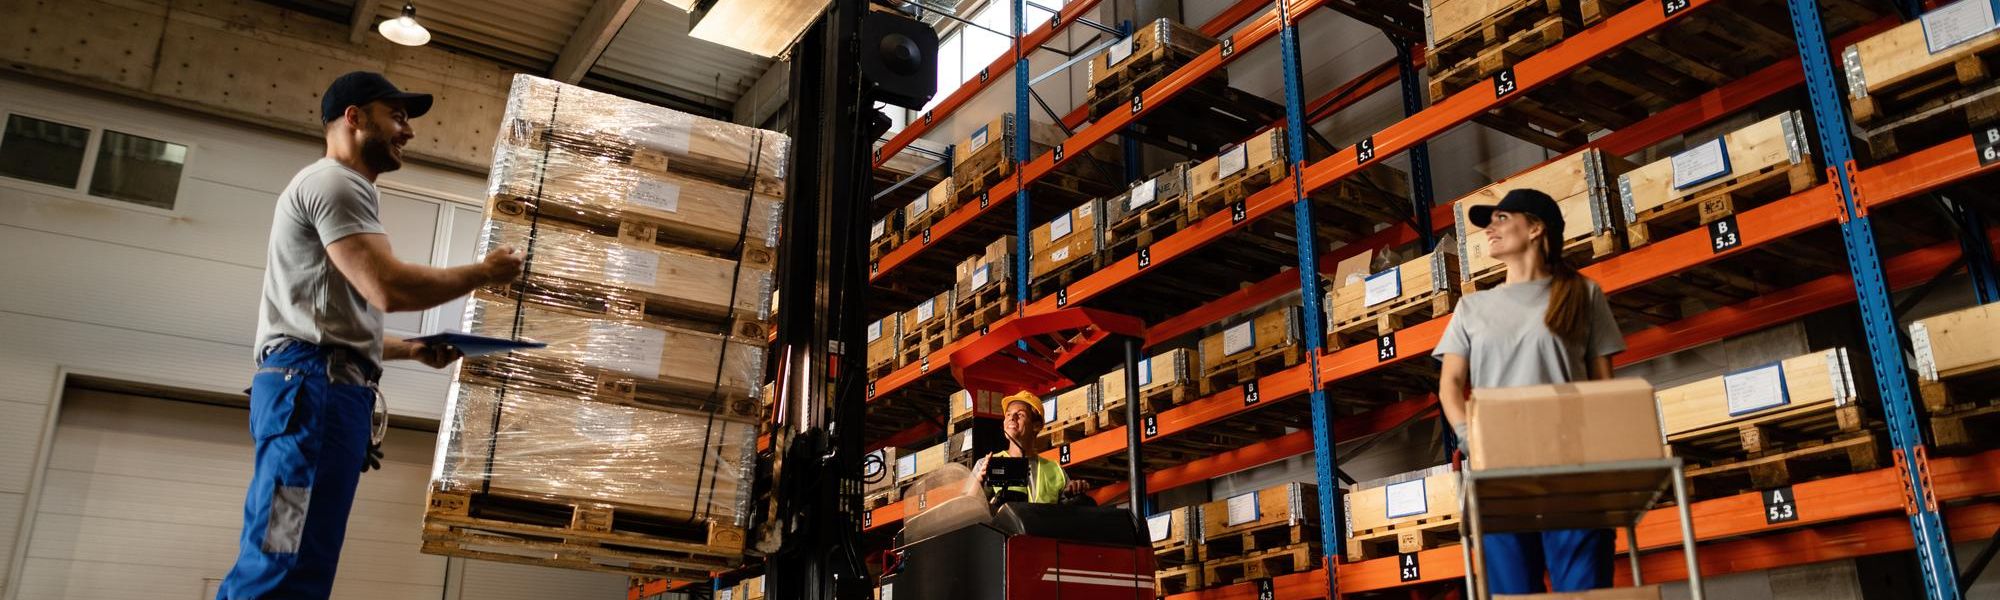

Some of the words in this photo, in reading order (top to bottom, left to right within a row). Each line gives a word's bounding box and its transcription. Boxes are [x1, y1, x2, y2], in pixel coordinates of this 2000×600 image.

[1667, 0, 1685, 13] 5.3
[1224, 39, 1230, 48] D
[1222, 45, 1232, 56] 4.3
[1500, 71, 1507, 81] C
[1498, 81, 1514, 95] 5.2
[1134, 96, 1140, 104] D
[1986, 129, 2000, 143] B
[1362, 139, 1368, 149] C
[1360, 148, 1372, 162] 5.1
[1236, 202, 1241, 211] C
[1234, 211, 1245, 221] 4.3
[1718, 221, 1728, 234] B
[1715, 233, 1736, 249] 5.3
[1141, 249, 1146, 257] C
[1060, 289, 1064, 297] C
[1383, 336, 1390, 347] B
[1380, 346, 1394, 359] 5.1
[1248, 383, 1254, 392] B
[1246, 392, 1258, 403] 4.3
[1148, 417, 1153, 426] B
[1146, 426, 1156, 435] 4.2
[1773, 489, 1784, 504] A
[1770, 505, 1793, 520] 5.3
[1406, 555, 1413, 566] A
[1403, 566, 1417, 579] 5.1
[1262, 580, 1269, 590] A
[1260, 591, 1273, 600] 4.3
